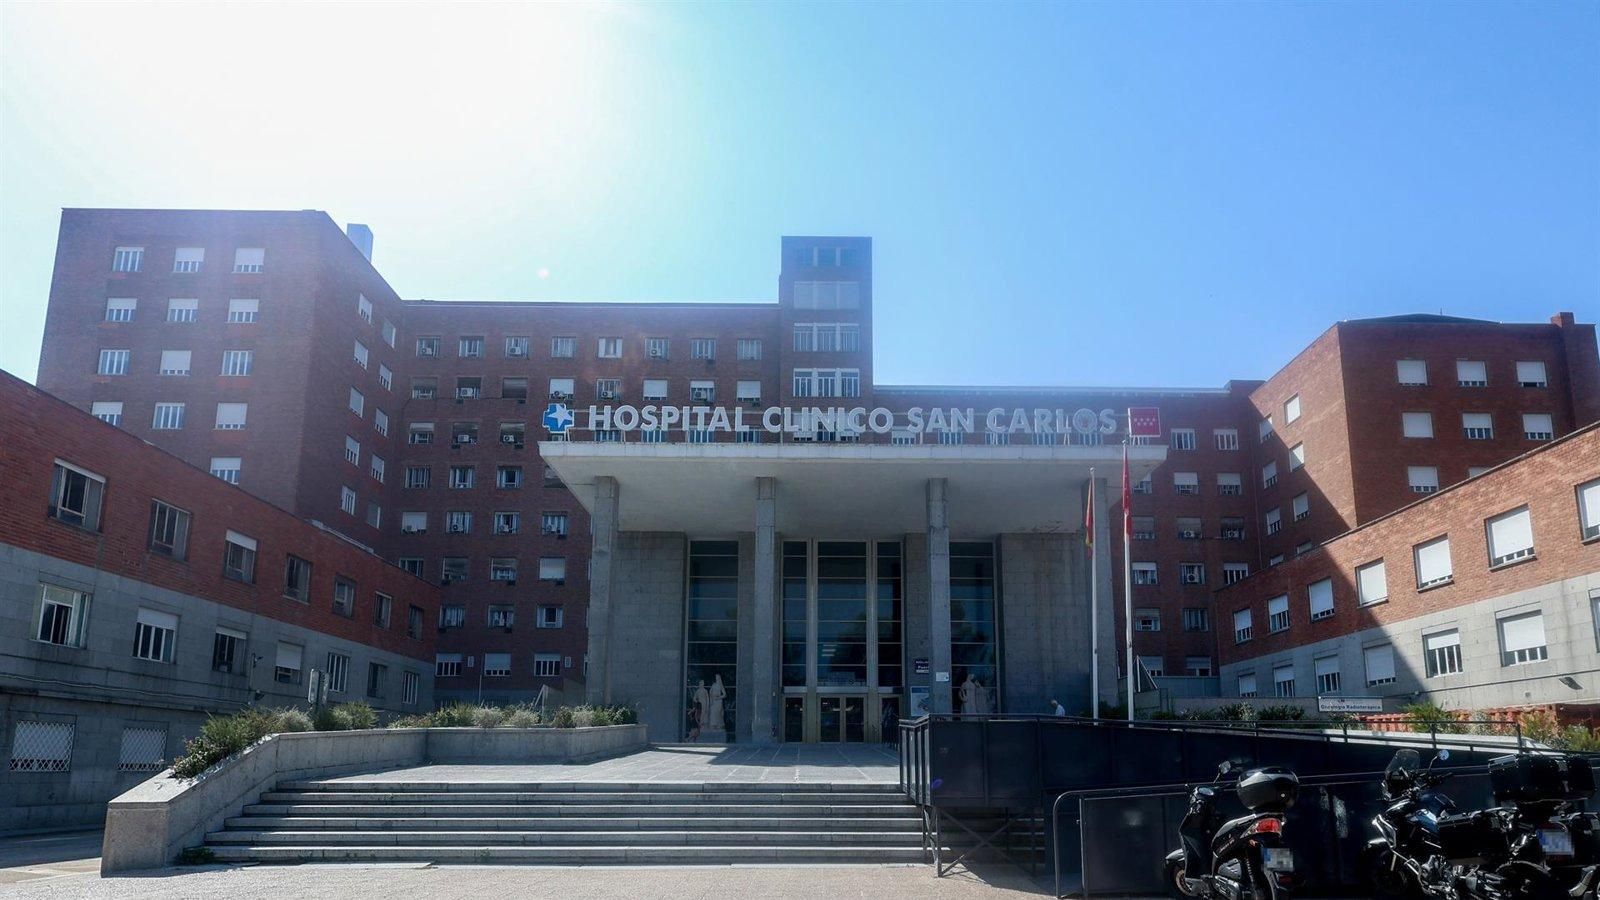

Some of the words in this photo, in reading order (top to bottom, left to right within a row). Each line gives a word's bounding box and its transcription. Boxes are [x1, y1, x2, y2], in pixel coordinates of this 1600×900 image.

[588, 404, 750, 432] HOSPITAL
[762, 406, 894, 433] CLINICO
[907, 406, 974, 434] SAN
[986, 408, 1117, 435] CARLOS
